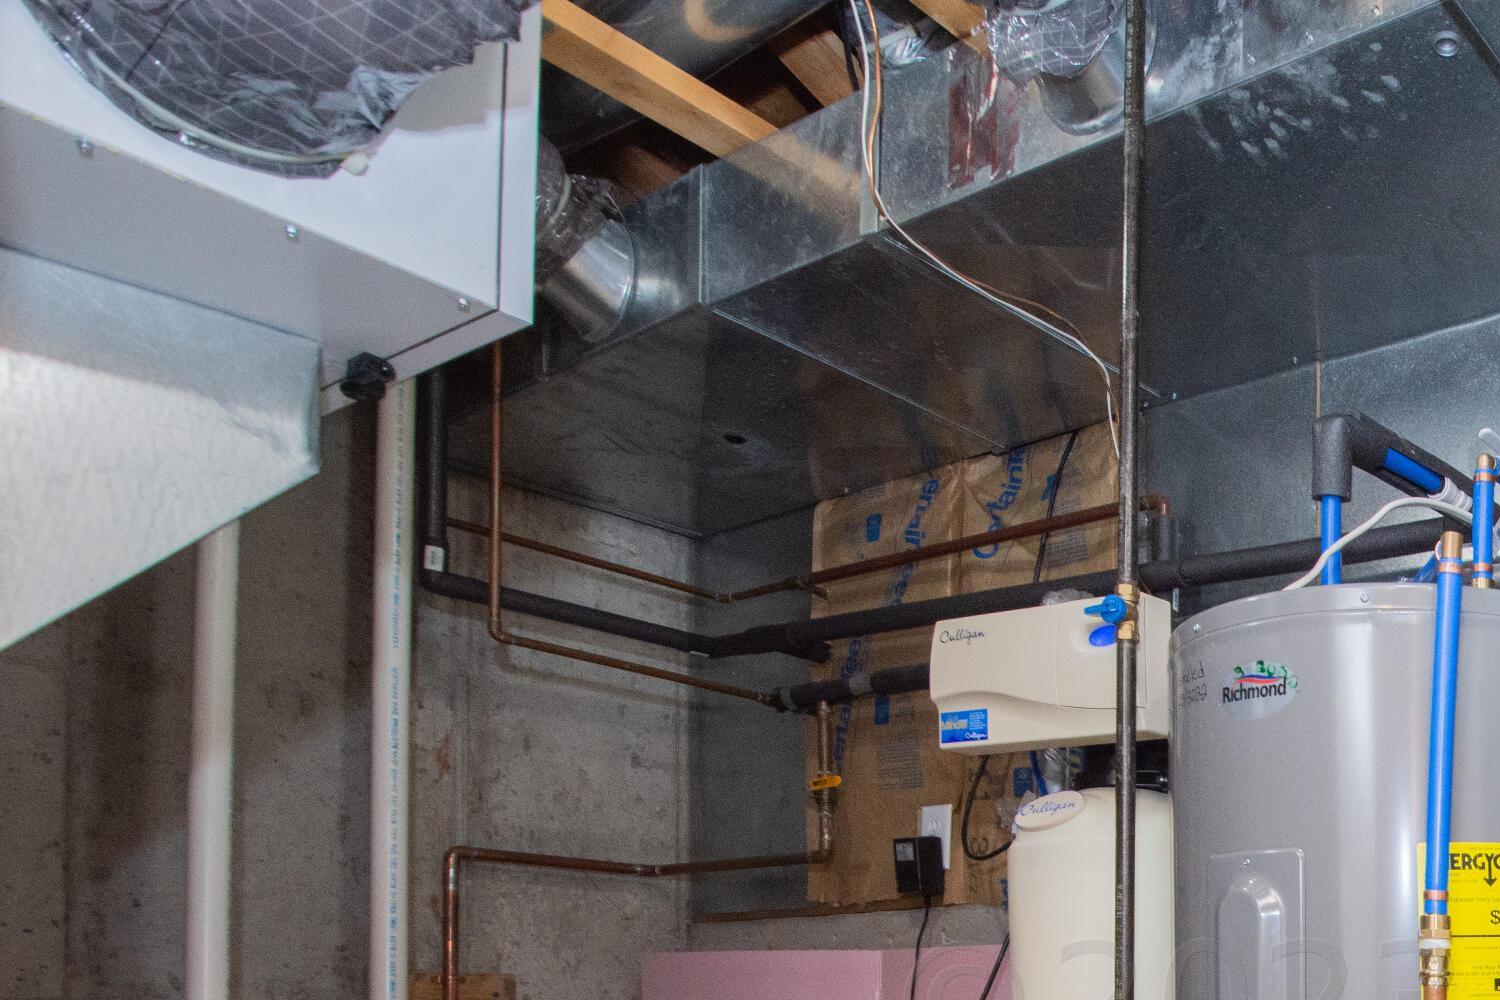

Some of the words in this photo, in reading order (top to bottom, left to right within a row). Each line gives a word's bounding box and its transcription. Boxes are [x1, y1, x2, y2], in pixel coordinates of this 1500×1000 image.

[939, 630, 986, 646] Culligan
[1222, 675, 1287, 703] Richmond
[1020, 798, 1076, 818] Culligan
